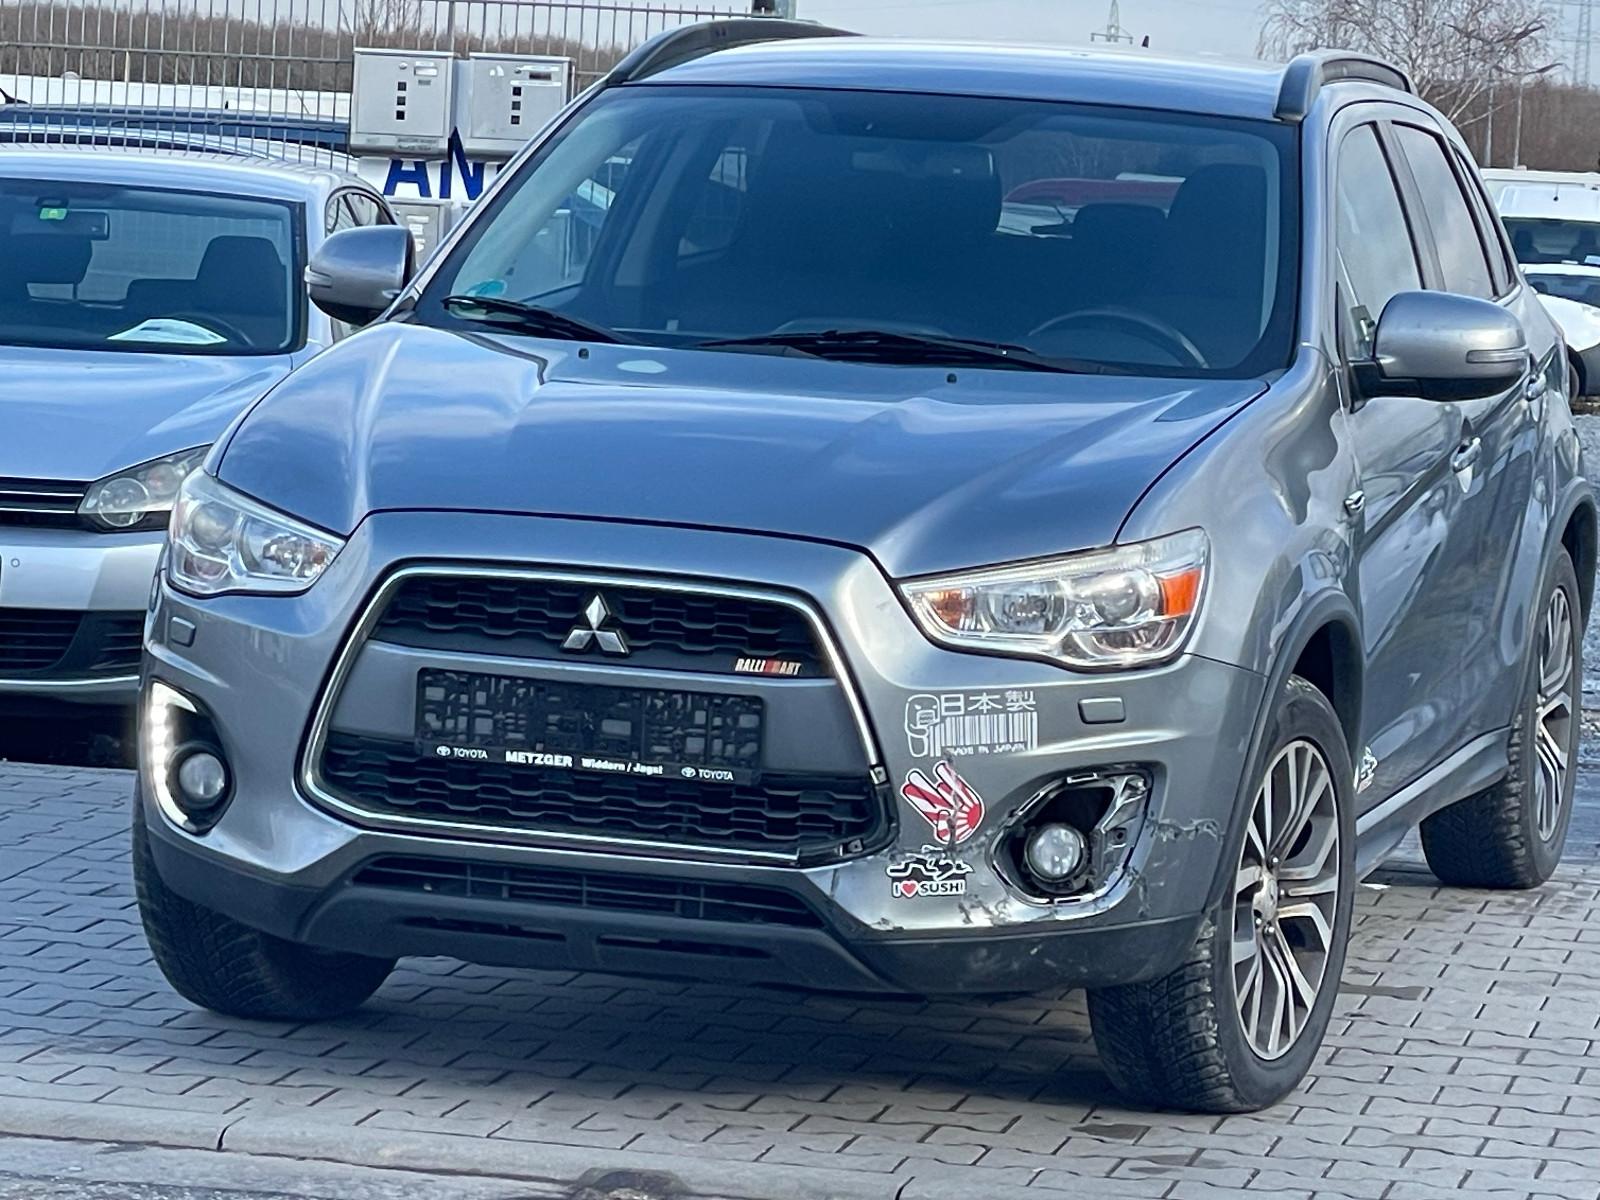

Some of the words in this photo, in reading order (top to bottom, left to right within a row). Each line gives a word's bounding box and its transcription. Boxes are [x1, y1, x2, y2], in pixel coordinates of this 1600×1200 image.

[383, 127, 507, 200] AN
[453, 747, 488, 759] TOYOTA
[505, 751, 573, 768] METZGER
[698, 768, 734, 781] TOYOTA
[920, 881, 964, 893] SUSHI
